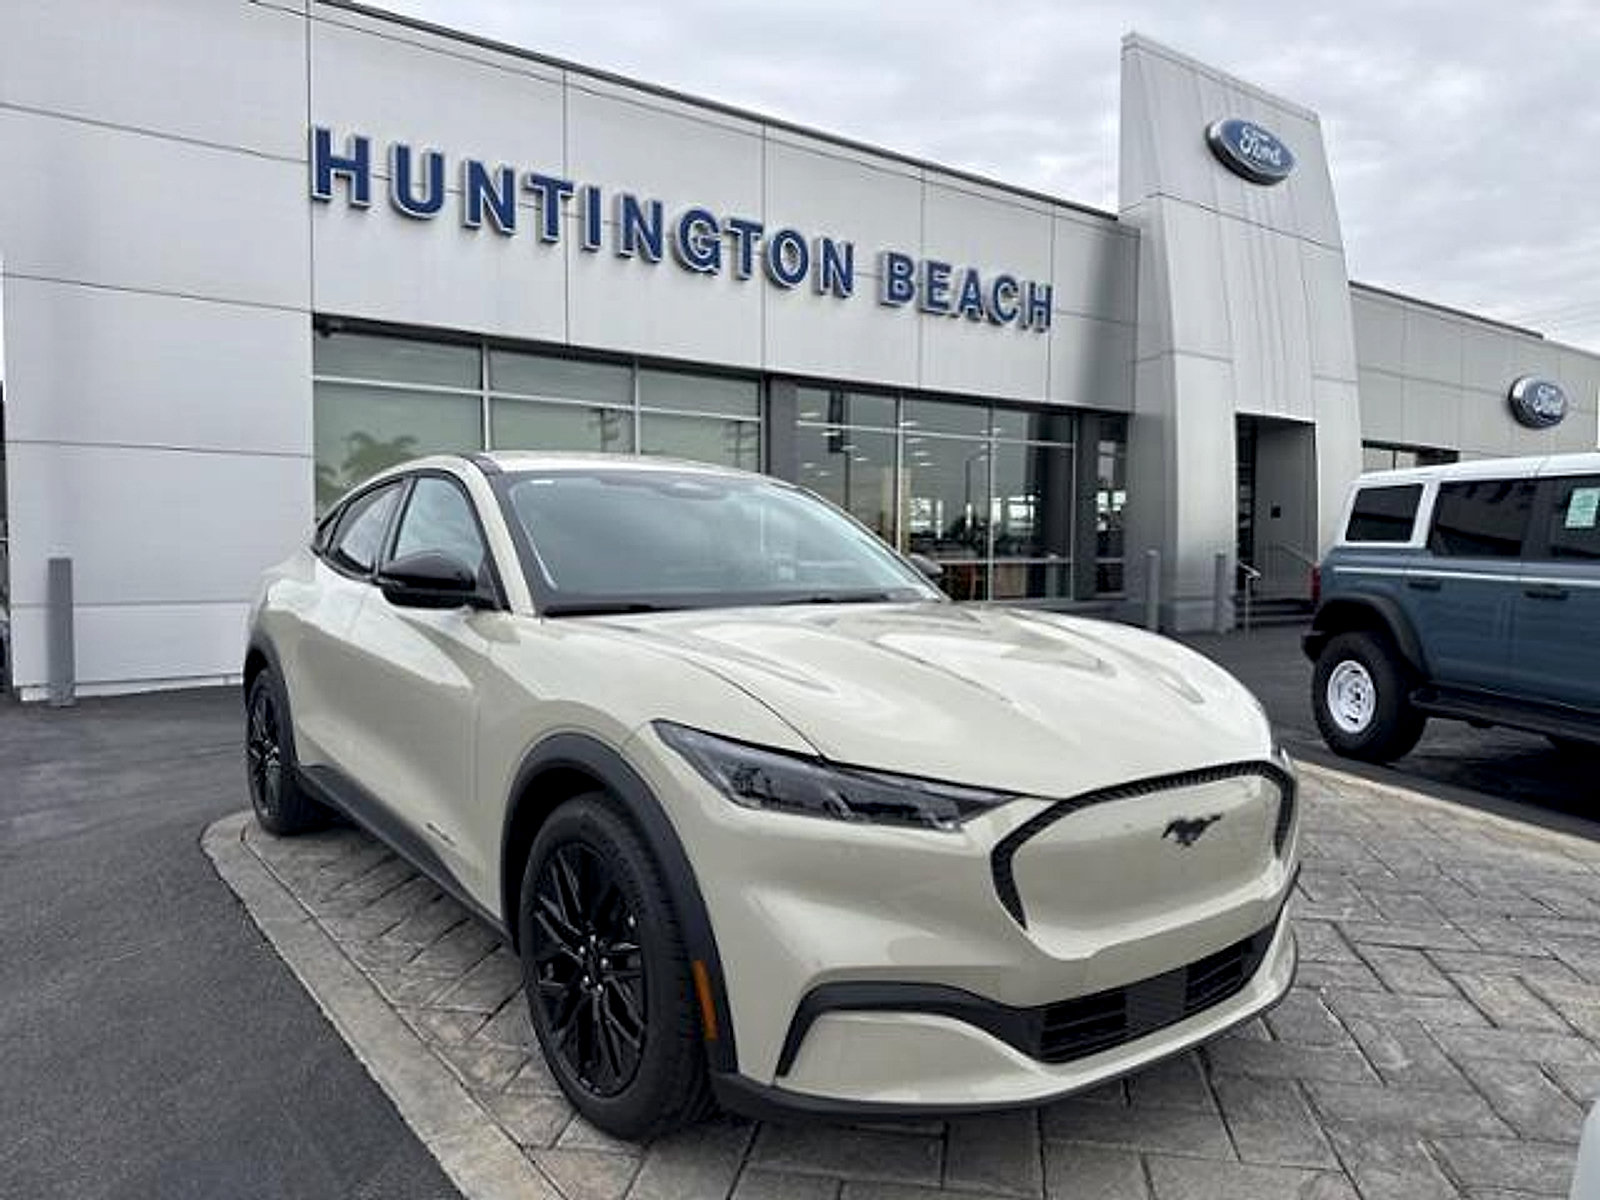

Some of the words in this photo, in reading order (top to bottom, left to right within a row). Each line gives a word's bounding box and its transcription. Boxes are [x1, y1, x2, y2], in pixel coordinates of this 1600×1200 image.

[1239, 125, 1283, 167] Ford
[311, 126, 855, 297] HUNTINGTON
[881, 251, 1053, 331] BEACH
